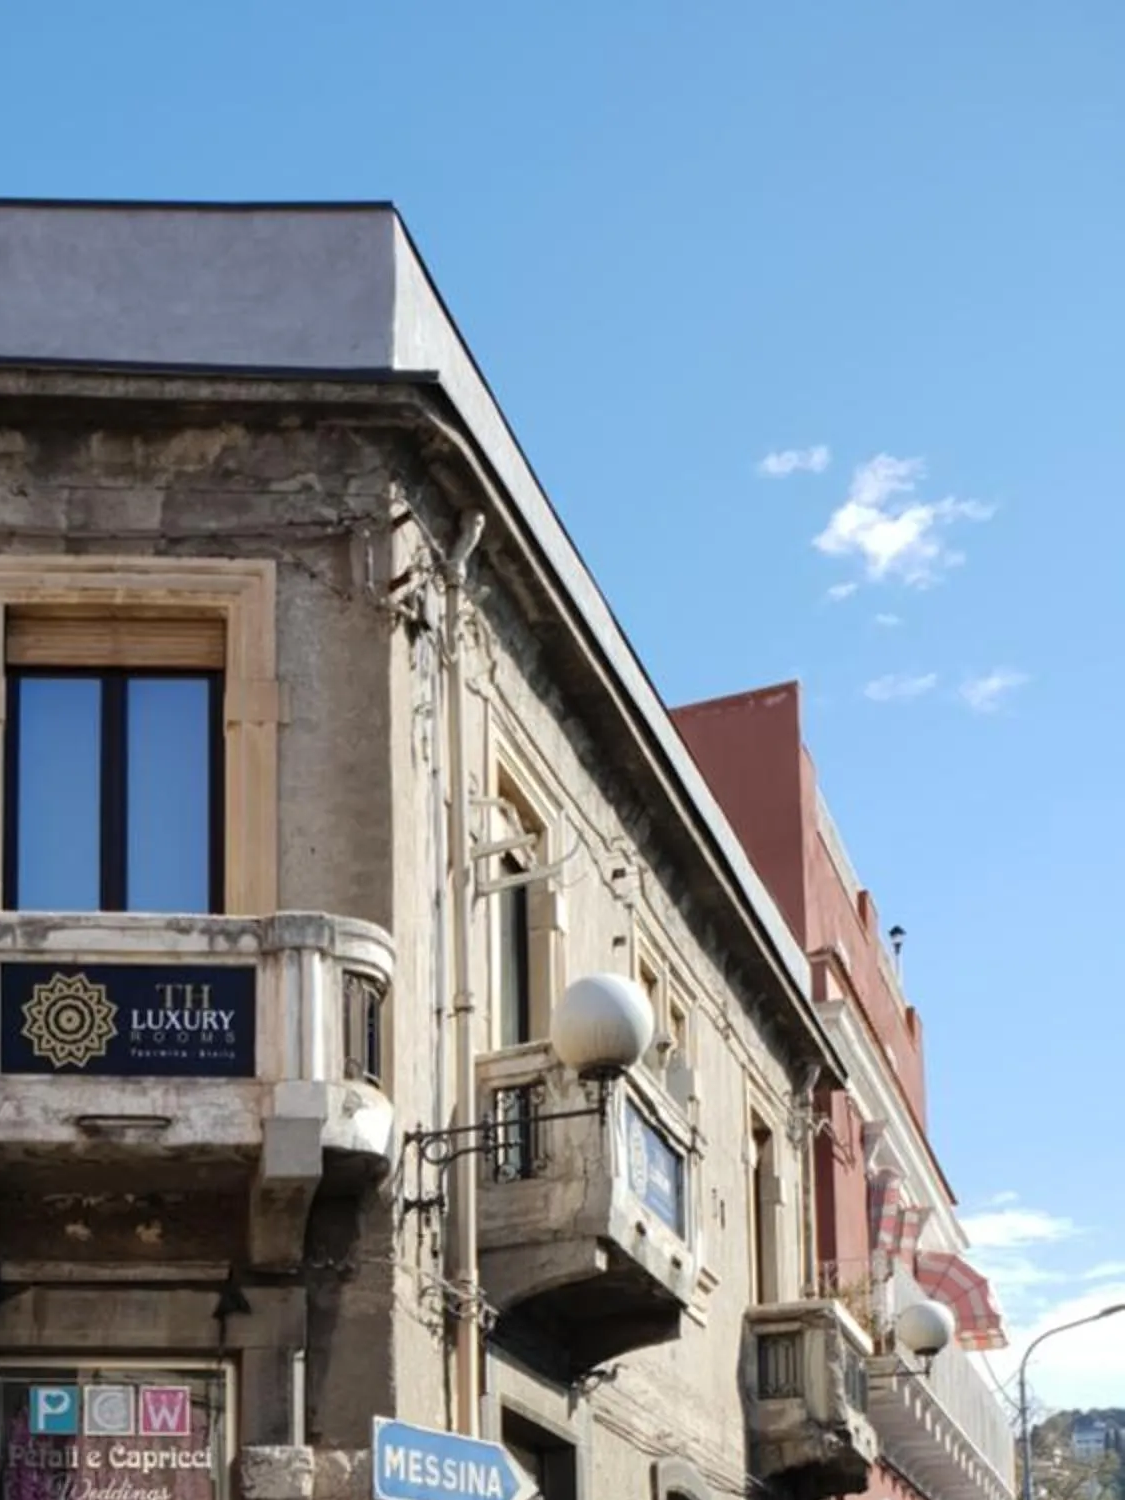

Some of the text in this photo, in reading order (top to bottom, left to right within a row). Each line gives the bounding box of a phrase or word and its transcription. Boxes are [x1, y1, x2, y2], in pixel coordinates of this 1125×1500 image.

[155, 983, 211, 1009] TH
[131, 1009, 235, 1031] LUXURY
[86, 1450, 102, 1469] e
[108, 1443, 212, 1474] Capricci
[384, 1443, 503, 1500] MESSINA
